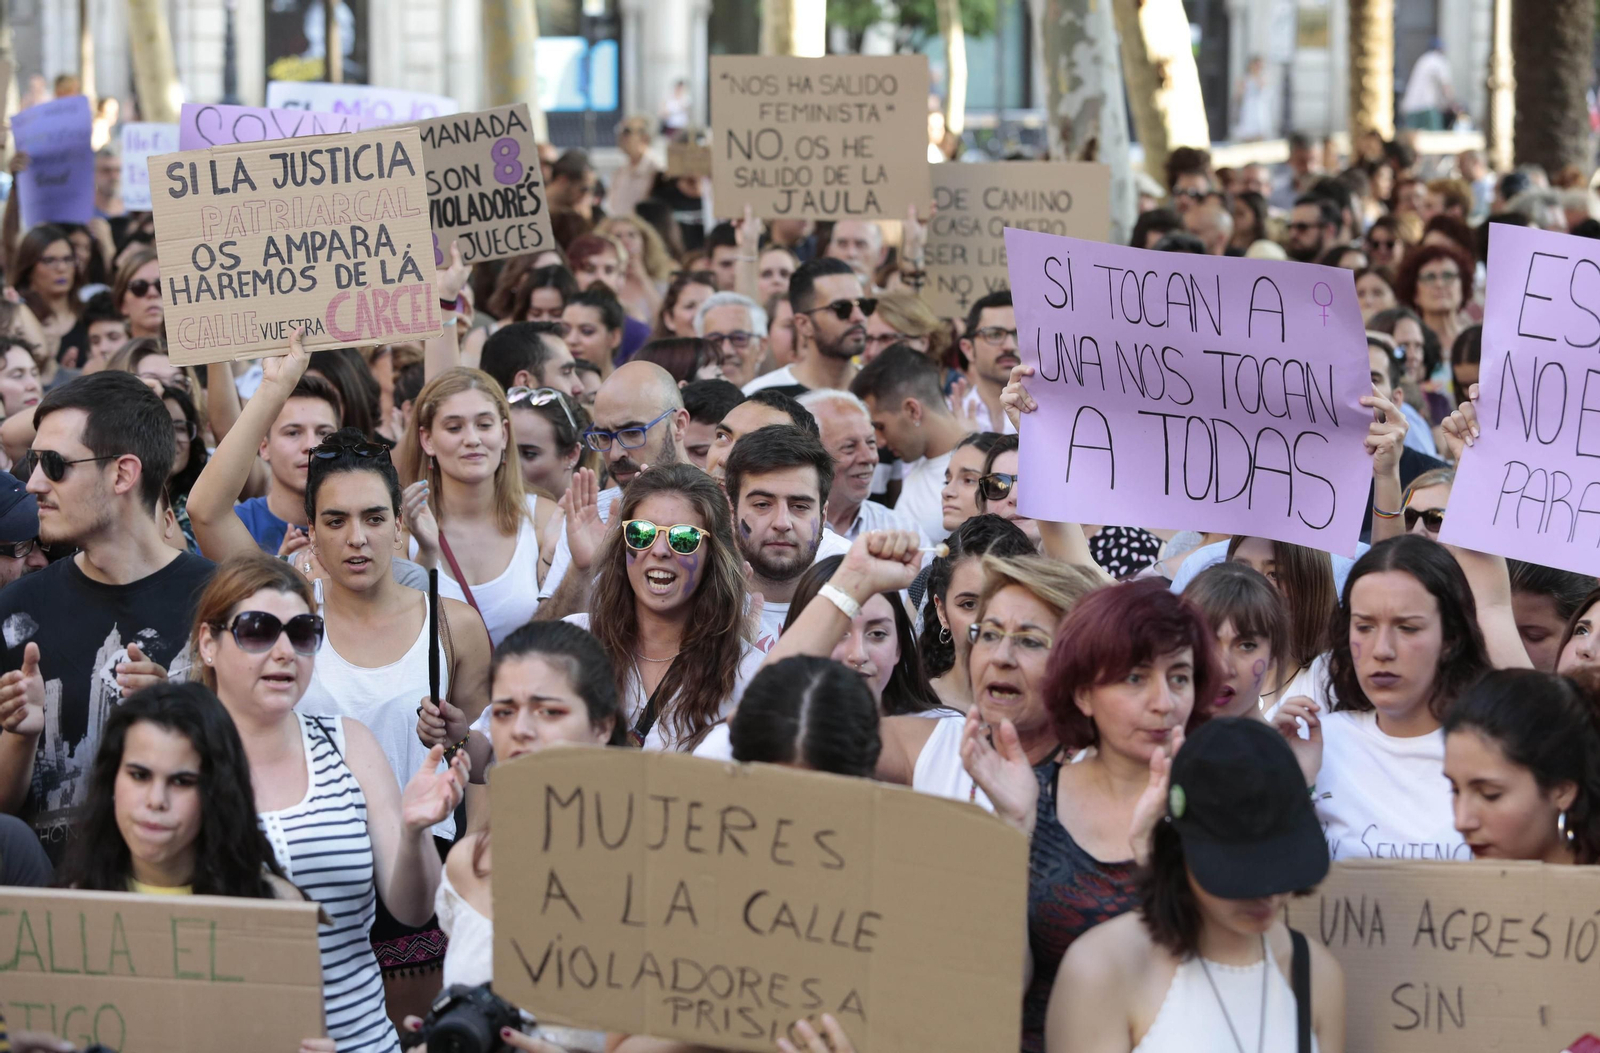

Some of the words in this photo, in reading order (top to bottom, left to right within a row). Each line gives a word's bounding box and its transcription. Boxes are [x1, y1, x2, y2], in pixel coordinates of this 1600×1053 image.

[788, 76, 813, 94] HA
[819, 74, 898, 96] SALIDO
[166, 161, 199, 199] SI
[209, 157, 257, 195] LA
[269, 140, 416, 189] JUSTICIA
[795, 135, 830, 161] OS
[842, 136, 874, 158] HE
[426, 163, 482, 196] SON
[734, 165, 813, 188] SALIDO
[824, 165, 849, 186] DE
[862, 164, 888, 185] LA
[201, 187, 421, 241] PATRIARCAL
[773, 189, 882, 214] JAULA
[934, 187, 969, 210] DE
[983, 187, 1073, 214] CAMINO
[459, 222, 543, 260] JUECES
[932, 216, 984, 237] CASA
[191, 240, 241, 272] OS
[924, 244, 968, 266] SER
[169, 265, 317, 306] HAREMOS
[334, 261, 366, 290] DE
[937, 275, 973, 304] NO
[1093, 264, 1222, 336] TOCAN
[1247, 276, 1286, 343] A
[177, 310, 260, 350] CALLE
[260, 318, 325, 340] VUESTRA
[325, 283, 440, 342] CÁRCEL
[1036, 327, 1104, 391] UNA
[1115, 341, 1194, 406] NOS
[1203, 350, 1339, 428] TOCAN
[1496, 350, 1567, 445] NO
[1065, 405, 1115, 490] A
[1138, 409, 1337, 531] TODAS
[541, 784, 845, 870] MUJERES
[541, 869, 583, 920] A
[620, 873, 699, 927] LA
[742, 890, 882, 952] CALLE
[1320, 894, 1385, 947] UNA
[171, 914, 245, 983] EL
[837, 988, 867, 1023] A
[1391, 982, 1465, 1033] SIN
